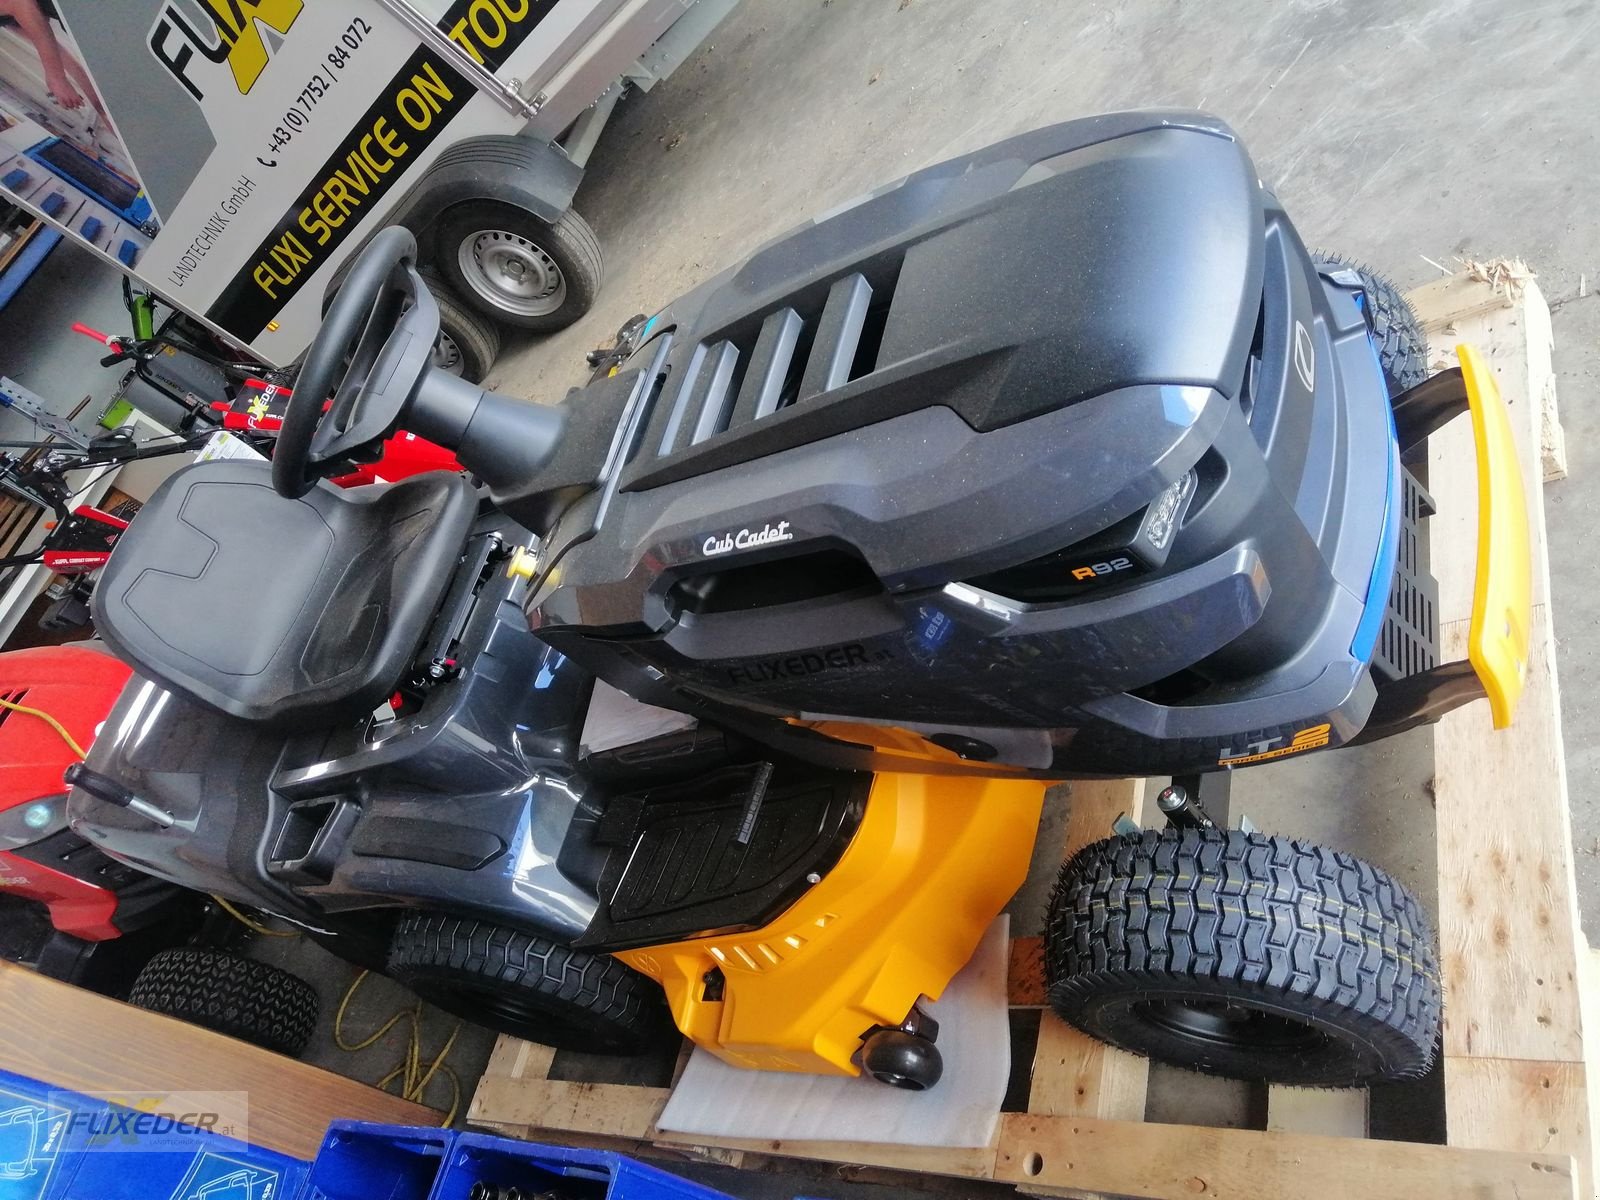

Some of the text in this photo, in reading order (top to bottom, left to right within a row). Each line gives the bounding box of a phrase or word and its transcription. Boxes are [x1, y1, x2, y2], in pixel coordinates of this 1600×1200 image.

[268, 126, 292, 153] +43
[282, 107, 310, 133] (0)
[296, 75, 330, 112] 7752
[328, 45, 351, 69] 84
[341, 17, 372, 51] 072
[298, 115, 409, 246] SERVICE
[396, 61, 454, 131] ON
[448, 0, 530, 65] TOU
[168, 174, 257, 287] LANDTECHNIK GmbH
[702, 521, 791, 556] Cub Cadet
[1071, 557, 1133, 580] R92
